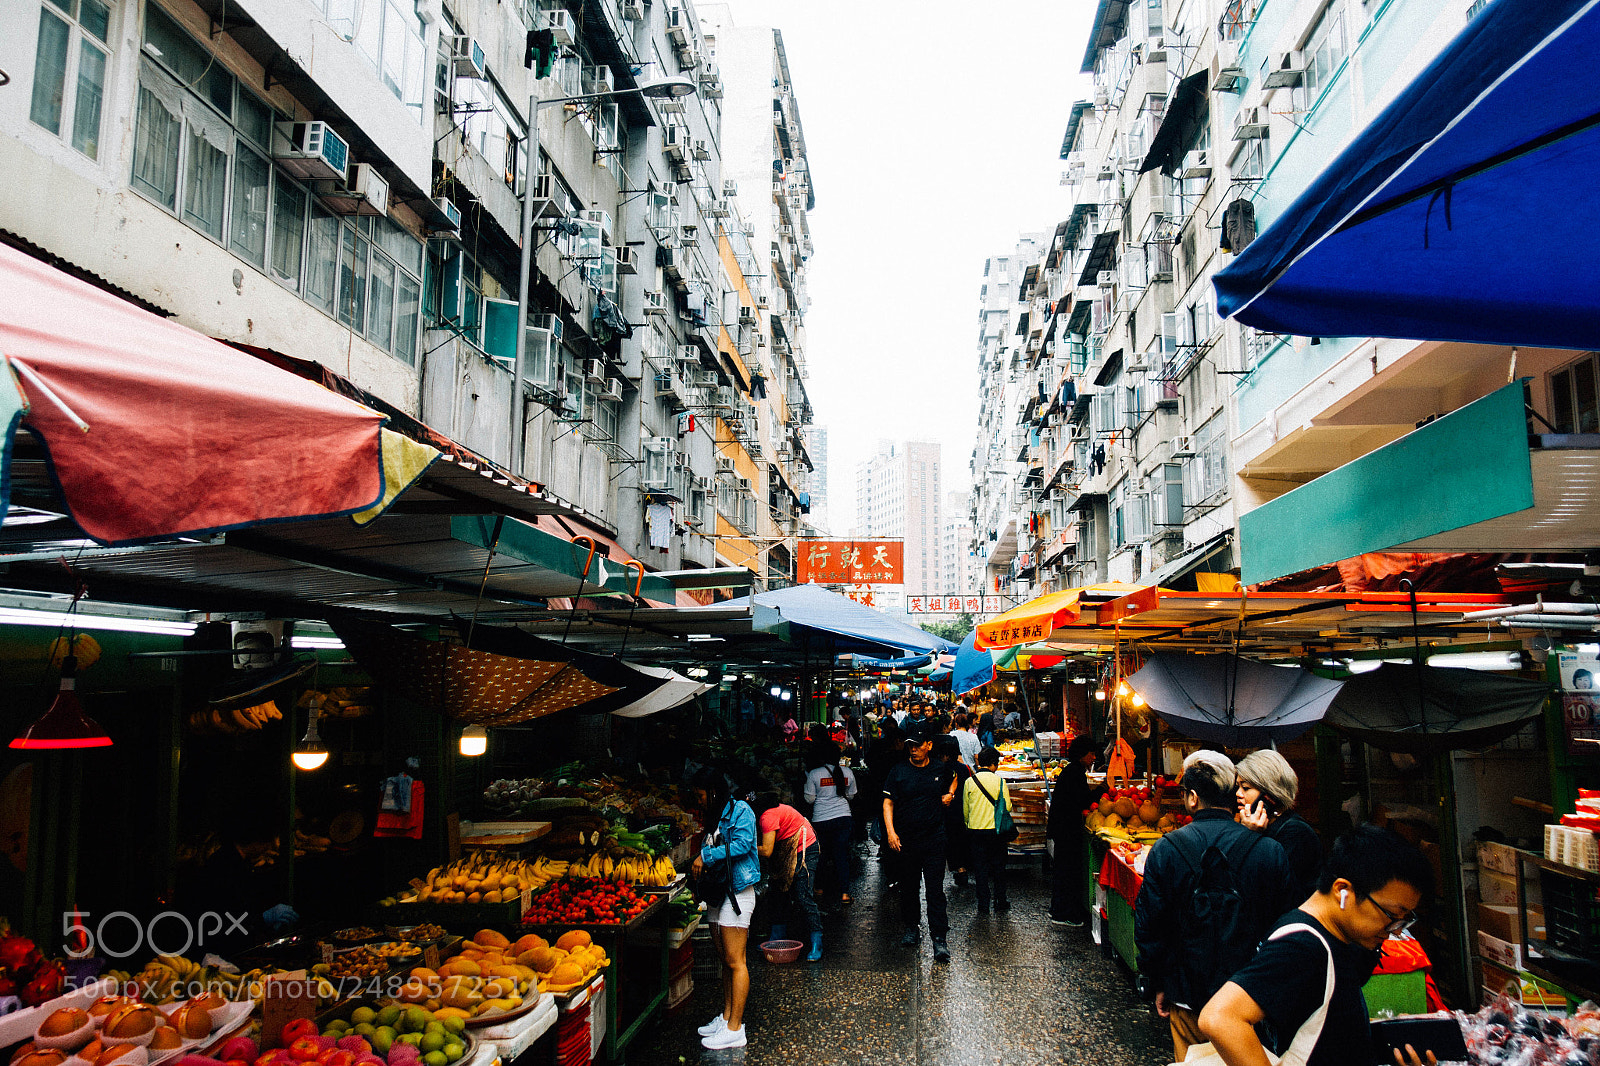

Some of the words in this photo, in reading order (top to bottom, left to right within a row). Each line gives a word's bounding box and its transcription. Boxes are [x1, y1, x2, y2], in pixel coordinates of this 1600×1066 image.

[911, 597, 979, 611] 笑姐雞鴨
[1568, 703, 1587, 719] 10
